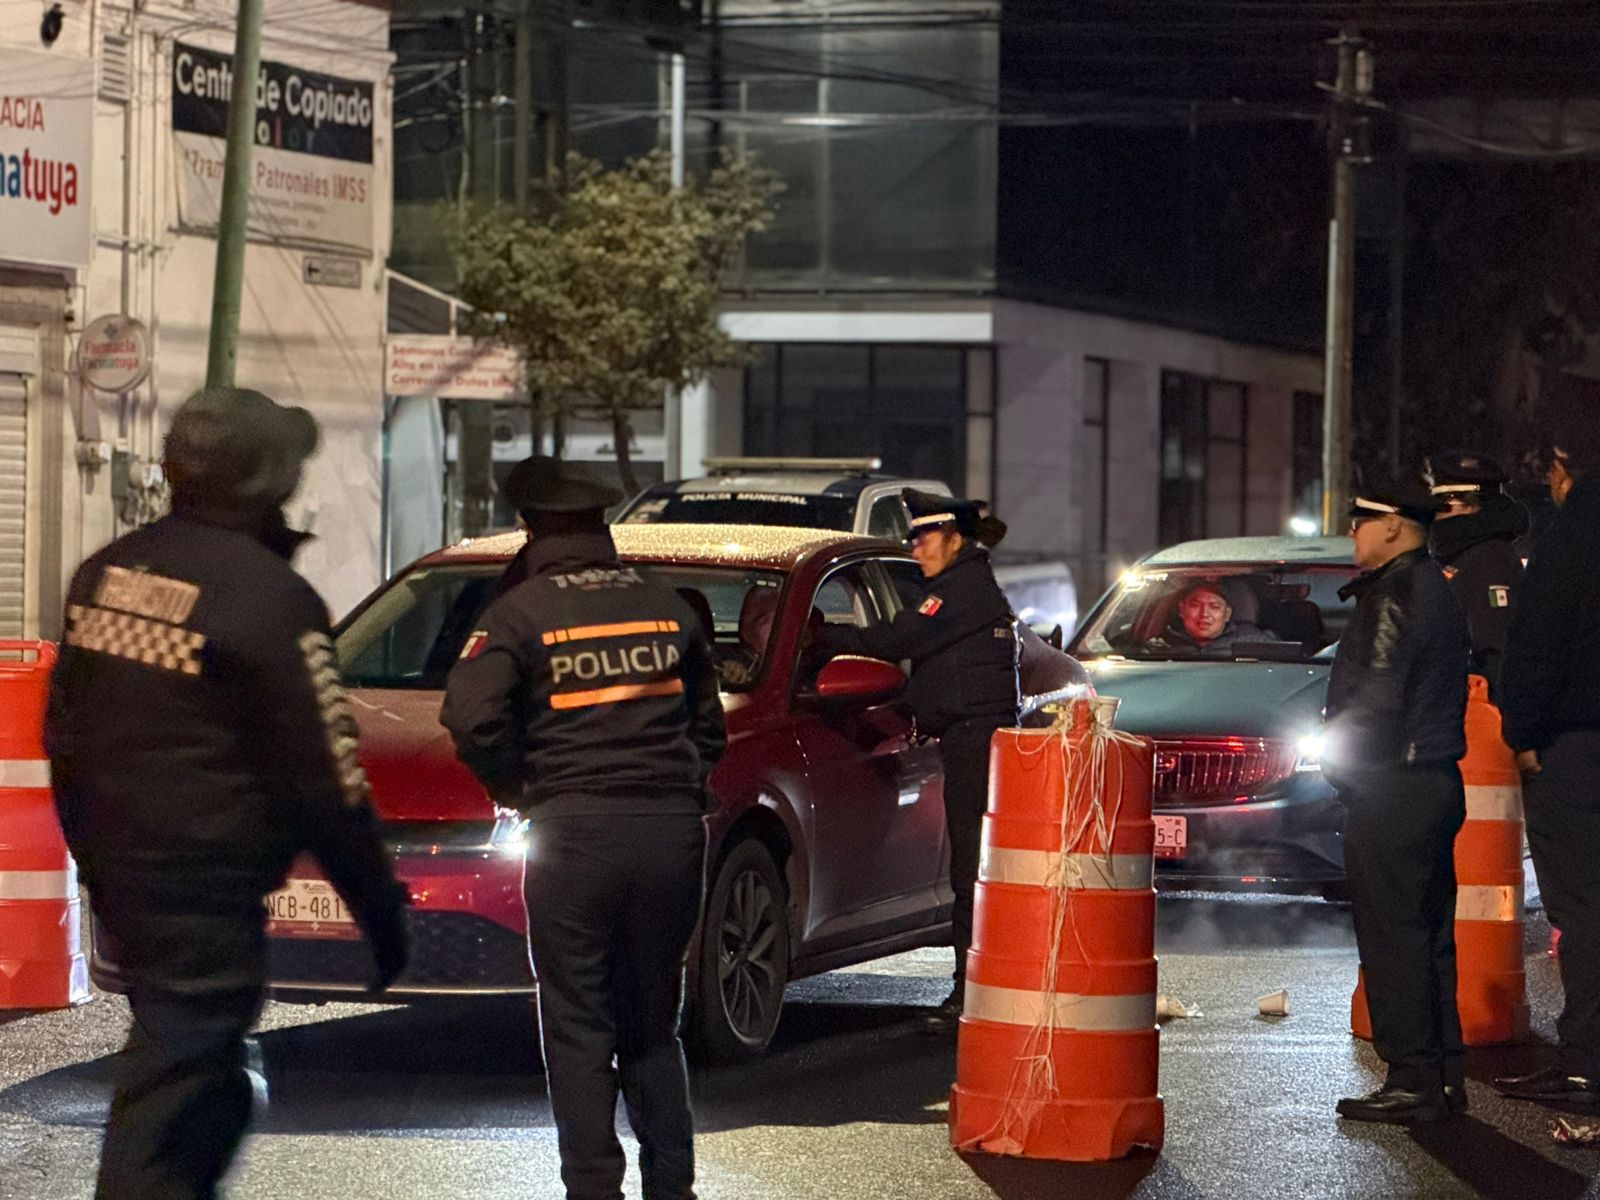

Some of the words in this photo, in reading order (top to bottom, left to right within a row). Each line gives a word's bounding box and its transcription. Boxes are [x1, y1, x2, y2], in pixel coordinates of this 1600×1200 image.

[175, 52, 234, 102] Centr
[256, 68, 281, 112] de
[285, 74, 374, 129] Copiado
[256, 118, 317, 152] olor
[255, 160, 330, 198] Patronales
[333, 174, 367, 204] IMSS
[736, 492, 808, 506] MUNICIPAL
[550, 641, 680, 684] POLICÍA
